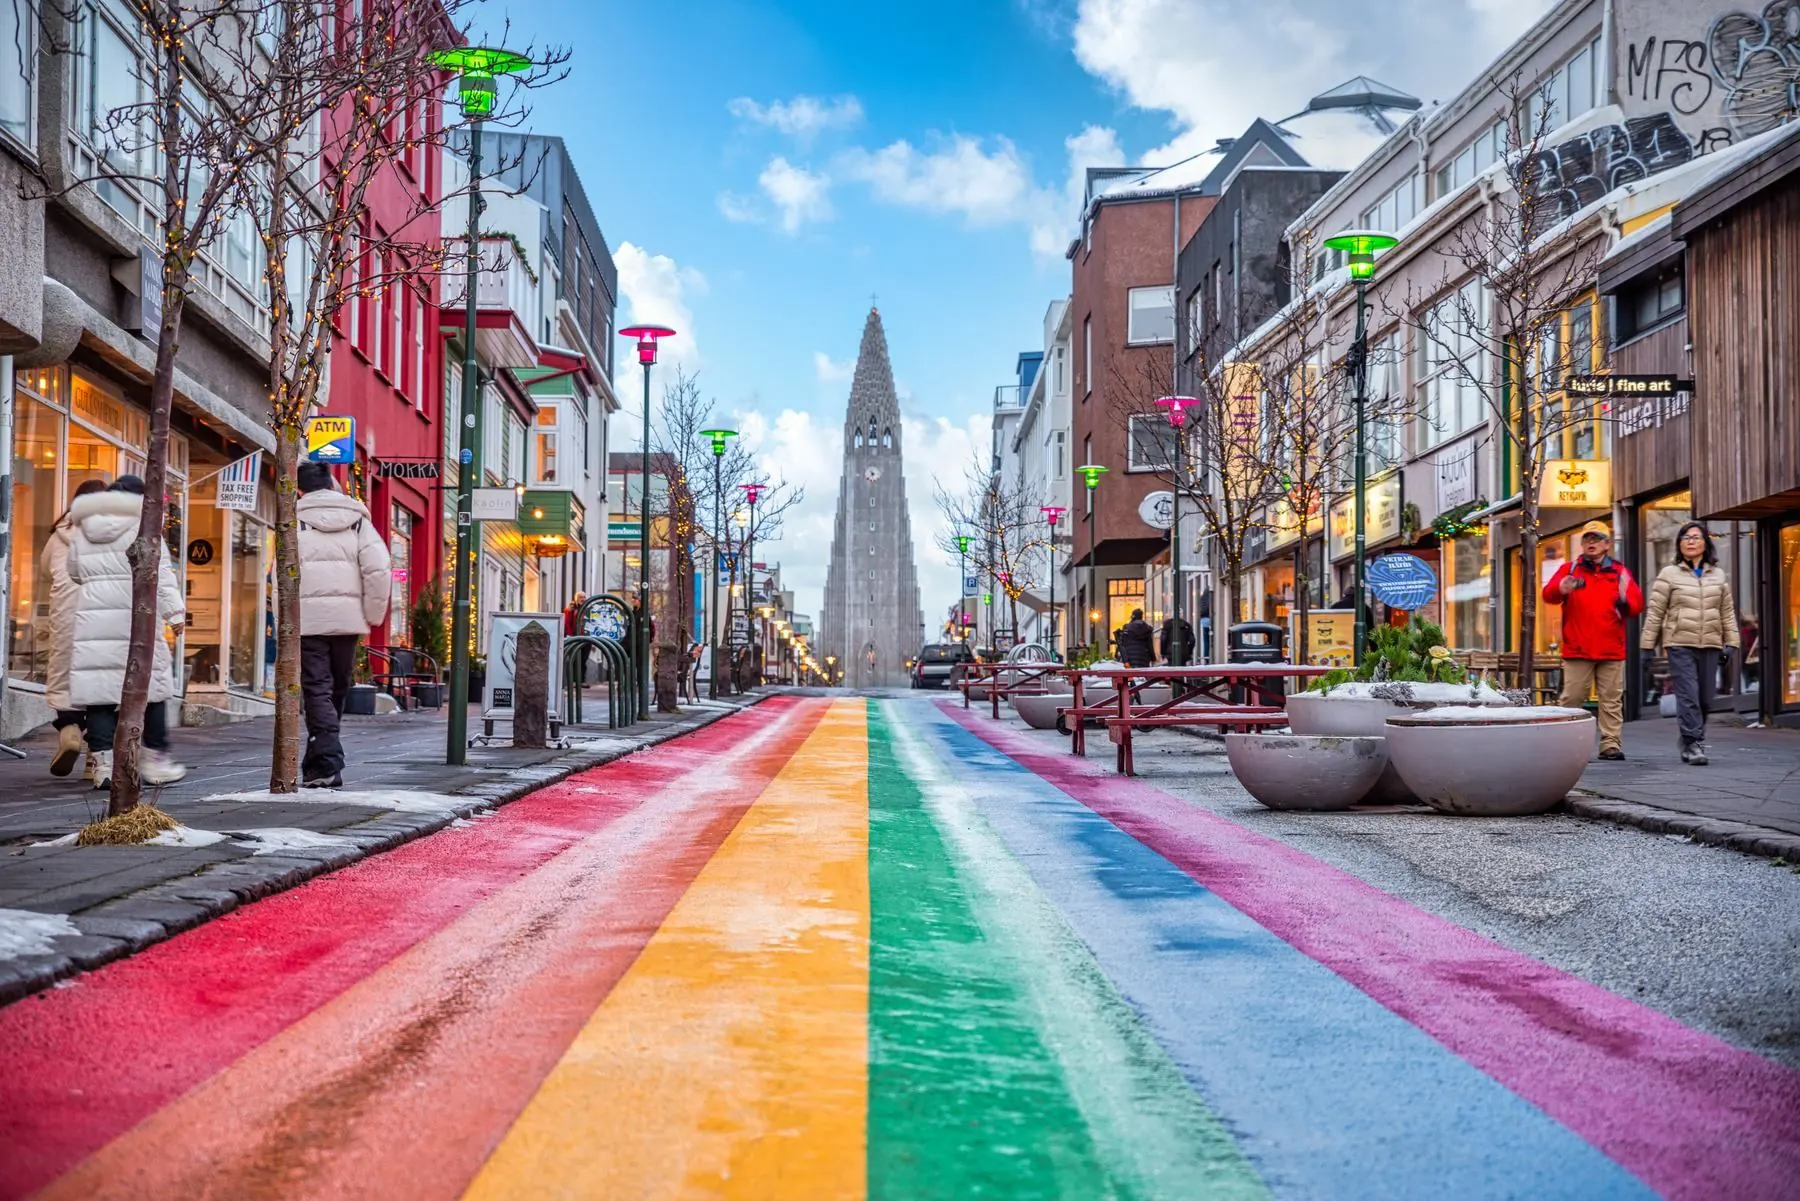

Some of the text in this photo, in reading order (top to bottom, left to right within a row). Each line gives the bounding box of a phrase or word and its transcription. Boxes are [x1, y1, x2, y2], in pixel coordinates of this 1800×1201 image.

[1629, 36, 1712, 115] MFS
[1616, 379, 1646, 391] fine
[1648, 380, 1672, 391] art
[314, 421, 346, 433] ATM
[380, 462, 439, 479] MOKKA
[222, 484, 254, 494] TAX FREE
[220, 493, 254, 503] SHOPPING
